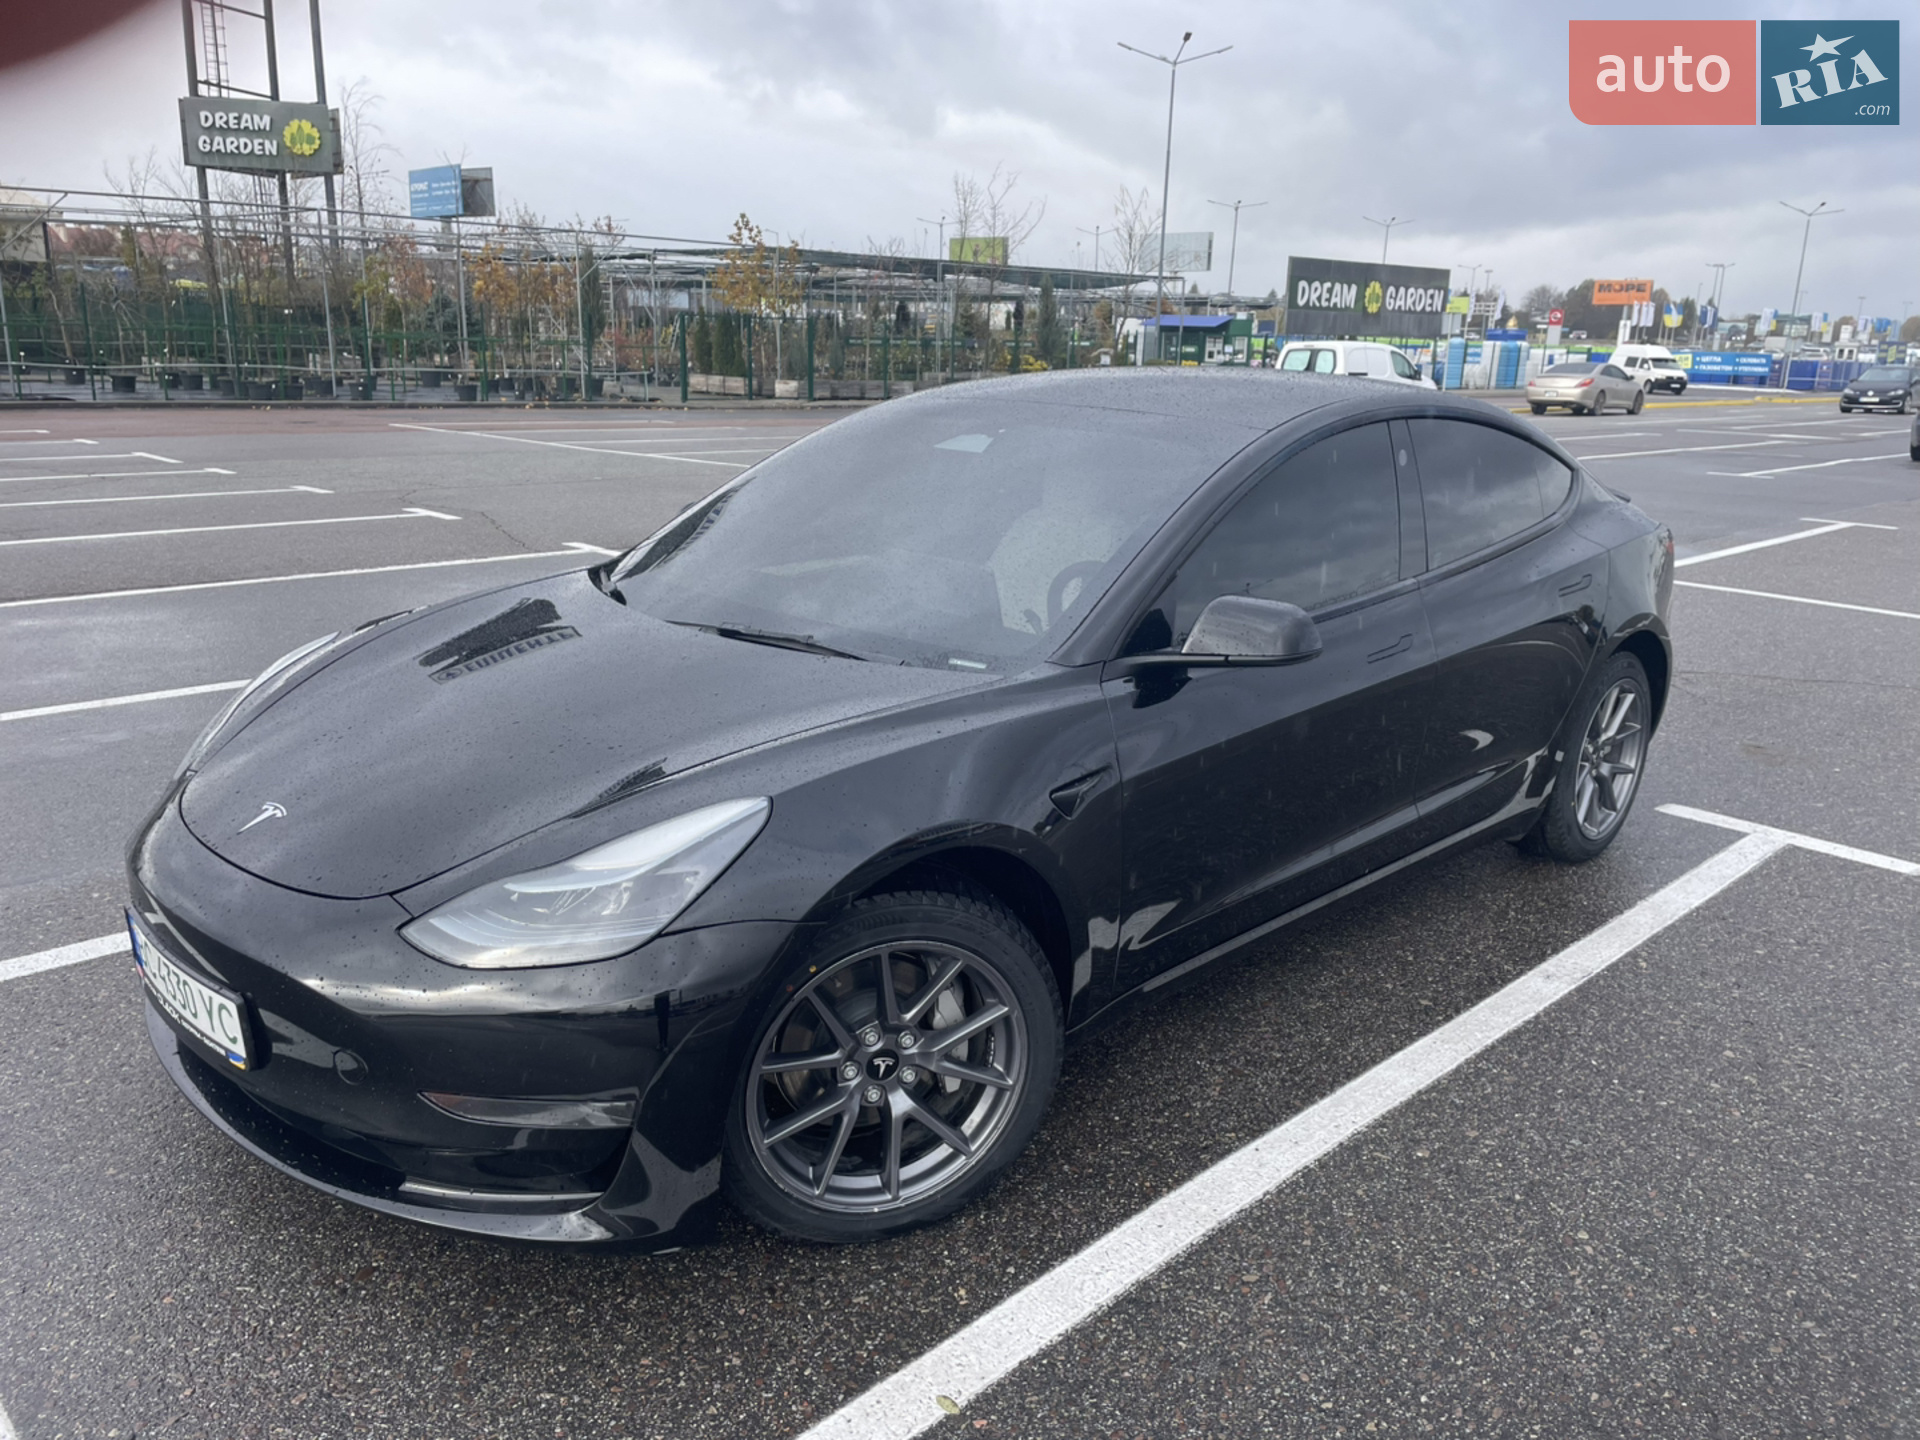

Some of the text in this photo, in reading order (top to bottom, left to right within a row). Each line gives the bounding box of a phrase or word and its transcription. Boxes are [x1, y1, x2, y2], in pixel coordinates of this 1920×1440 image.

[199, 111, 271, 131] DREAM
[197, 135, 278, 156] GARDEN
[1297, 280, 1444, 312] DREAM GARDEN
[198, 988, 238, 1045] YC
